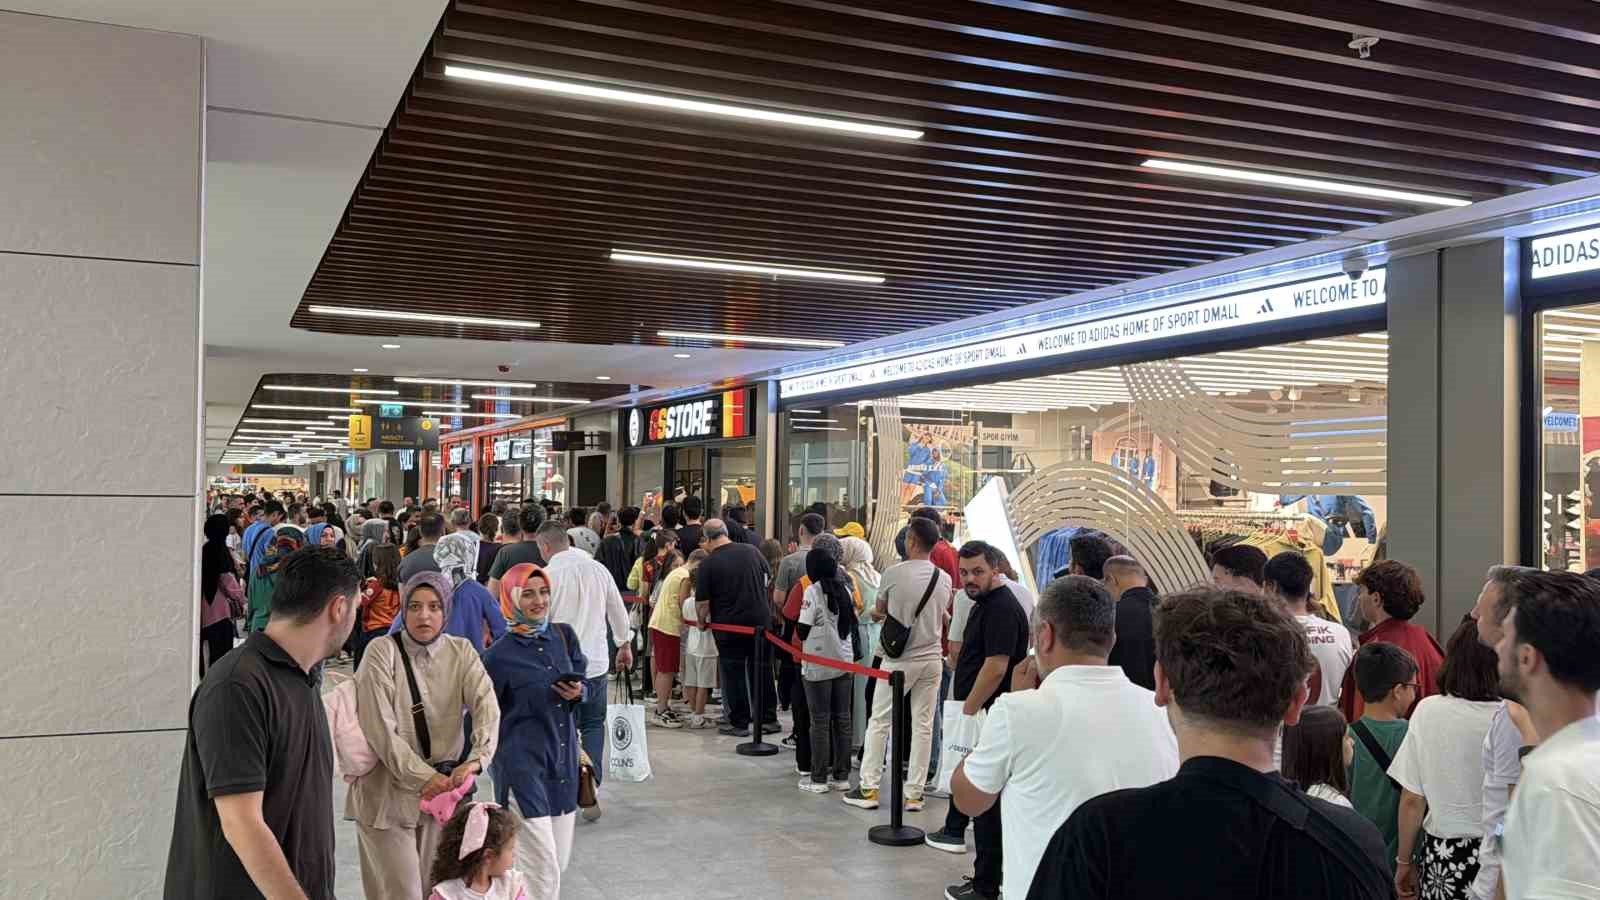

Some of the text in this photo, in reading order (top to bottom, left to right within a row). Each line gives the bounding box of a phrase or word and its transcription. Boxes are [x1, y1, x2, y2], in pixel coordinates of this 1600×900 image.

[1531, 238, 1600, 268] ADIDAS
[1293, 282, 1358, 309] WELCOME
[1362, 278, 1378, 297] TO
[1038, 303, 1239, 352] WELCOME TO ADIDAS HOME OF SPORT DMALL
